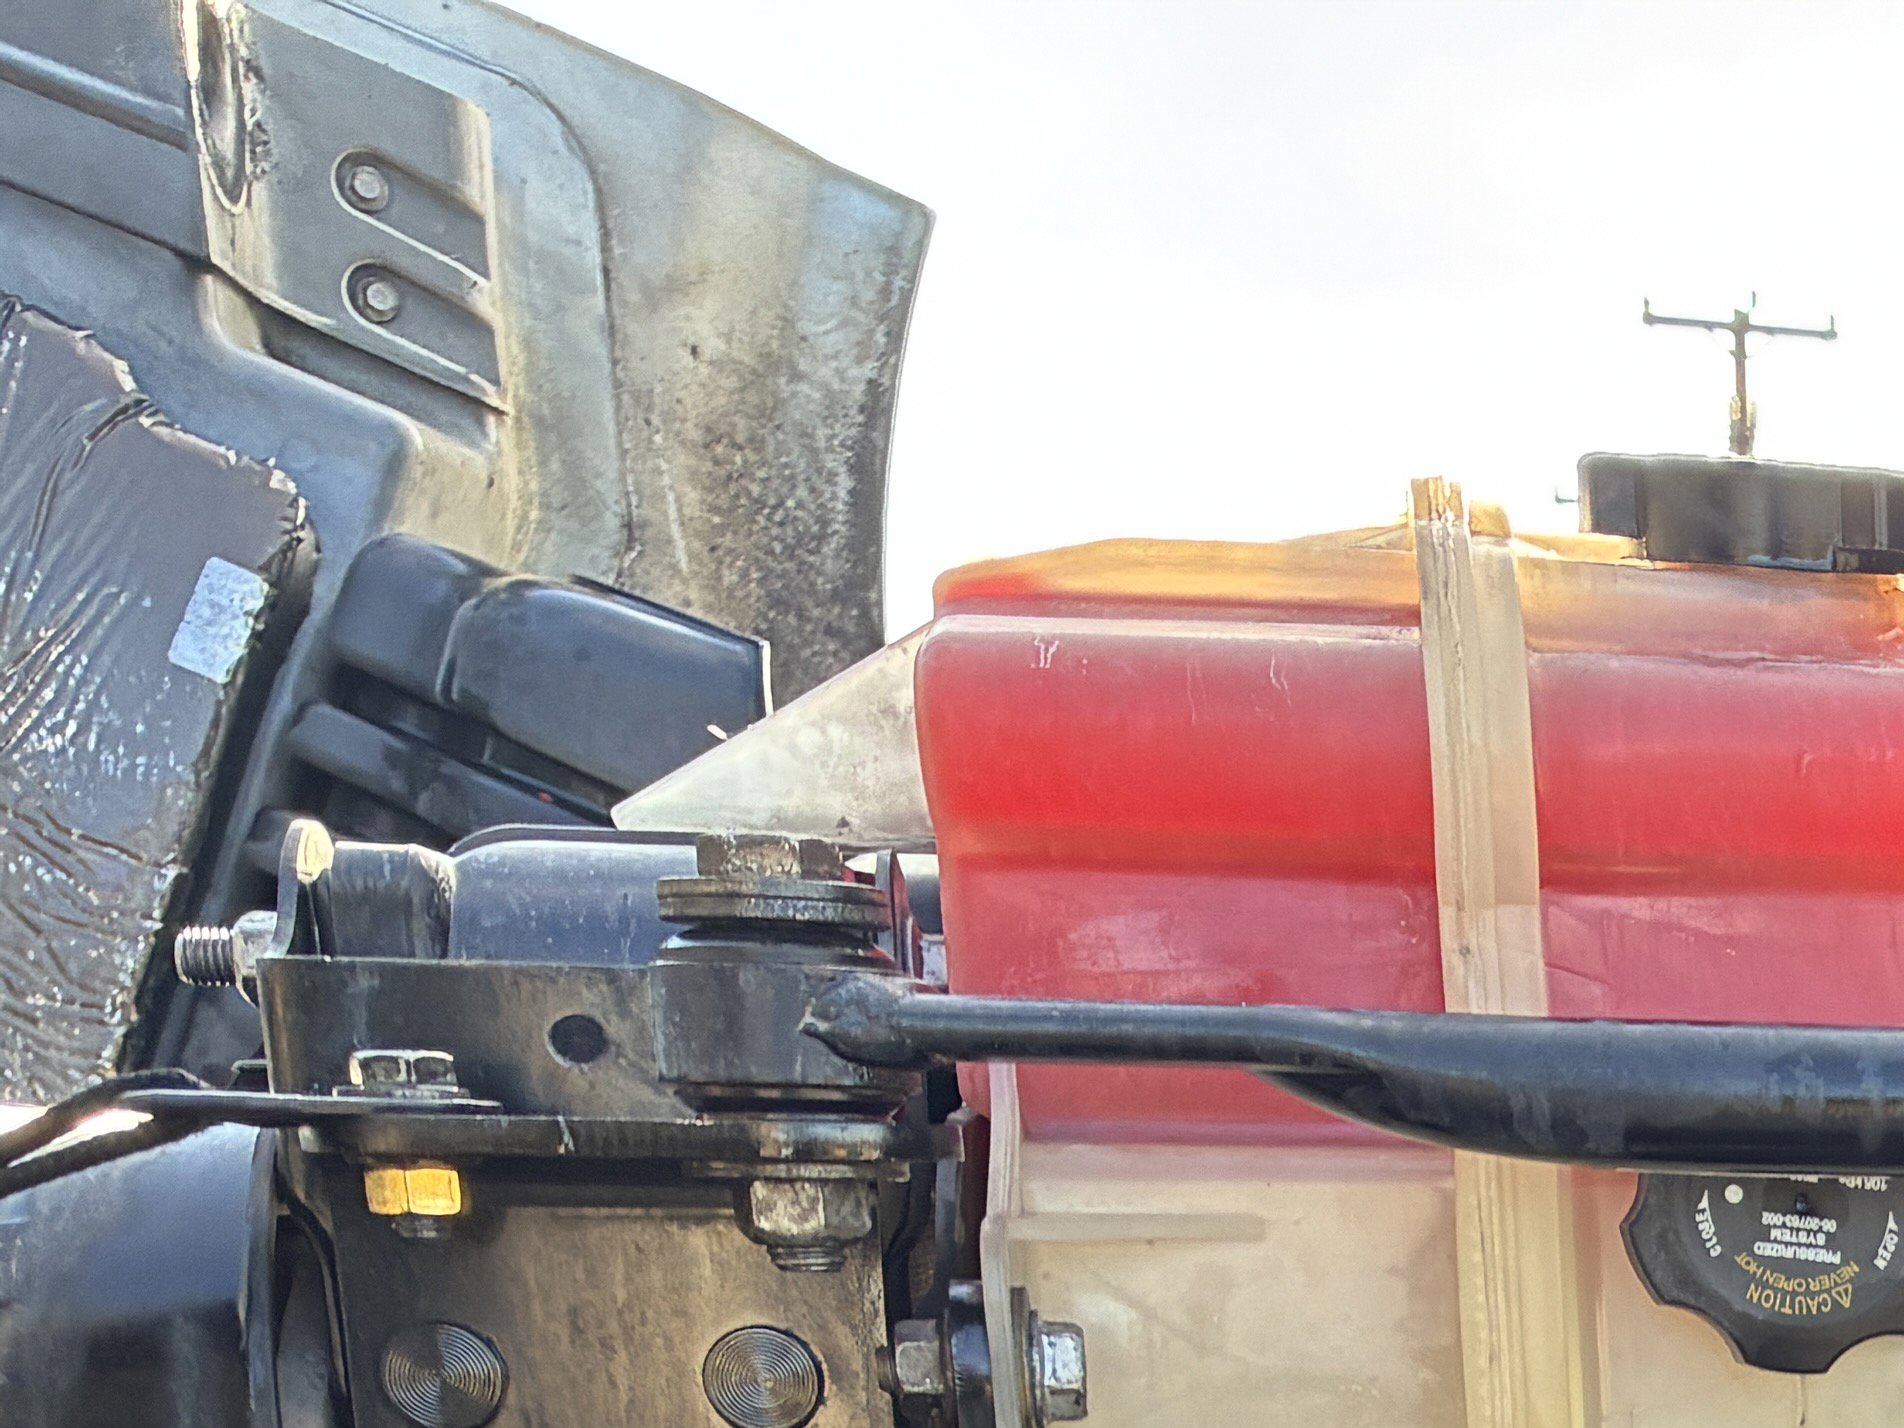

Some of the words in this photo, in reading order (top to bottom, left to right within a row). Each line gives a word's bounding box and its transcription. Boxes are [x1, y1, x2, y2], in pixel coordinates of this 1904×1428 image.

[1770, 1229, 1825, 1245] SYSTEM
[1734, 1251, 1764, 1279] HOT
[1754, 1242, 1841, 1264] PRESSURIZED
[1764, 1268, 1808, 1294] OPEN
[1808, 1260, 1860, 1292] NEVER
[1746, 1282, 1833, 1316] CAUTION
